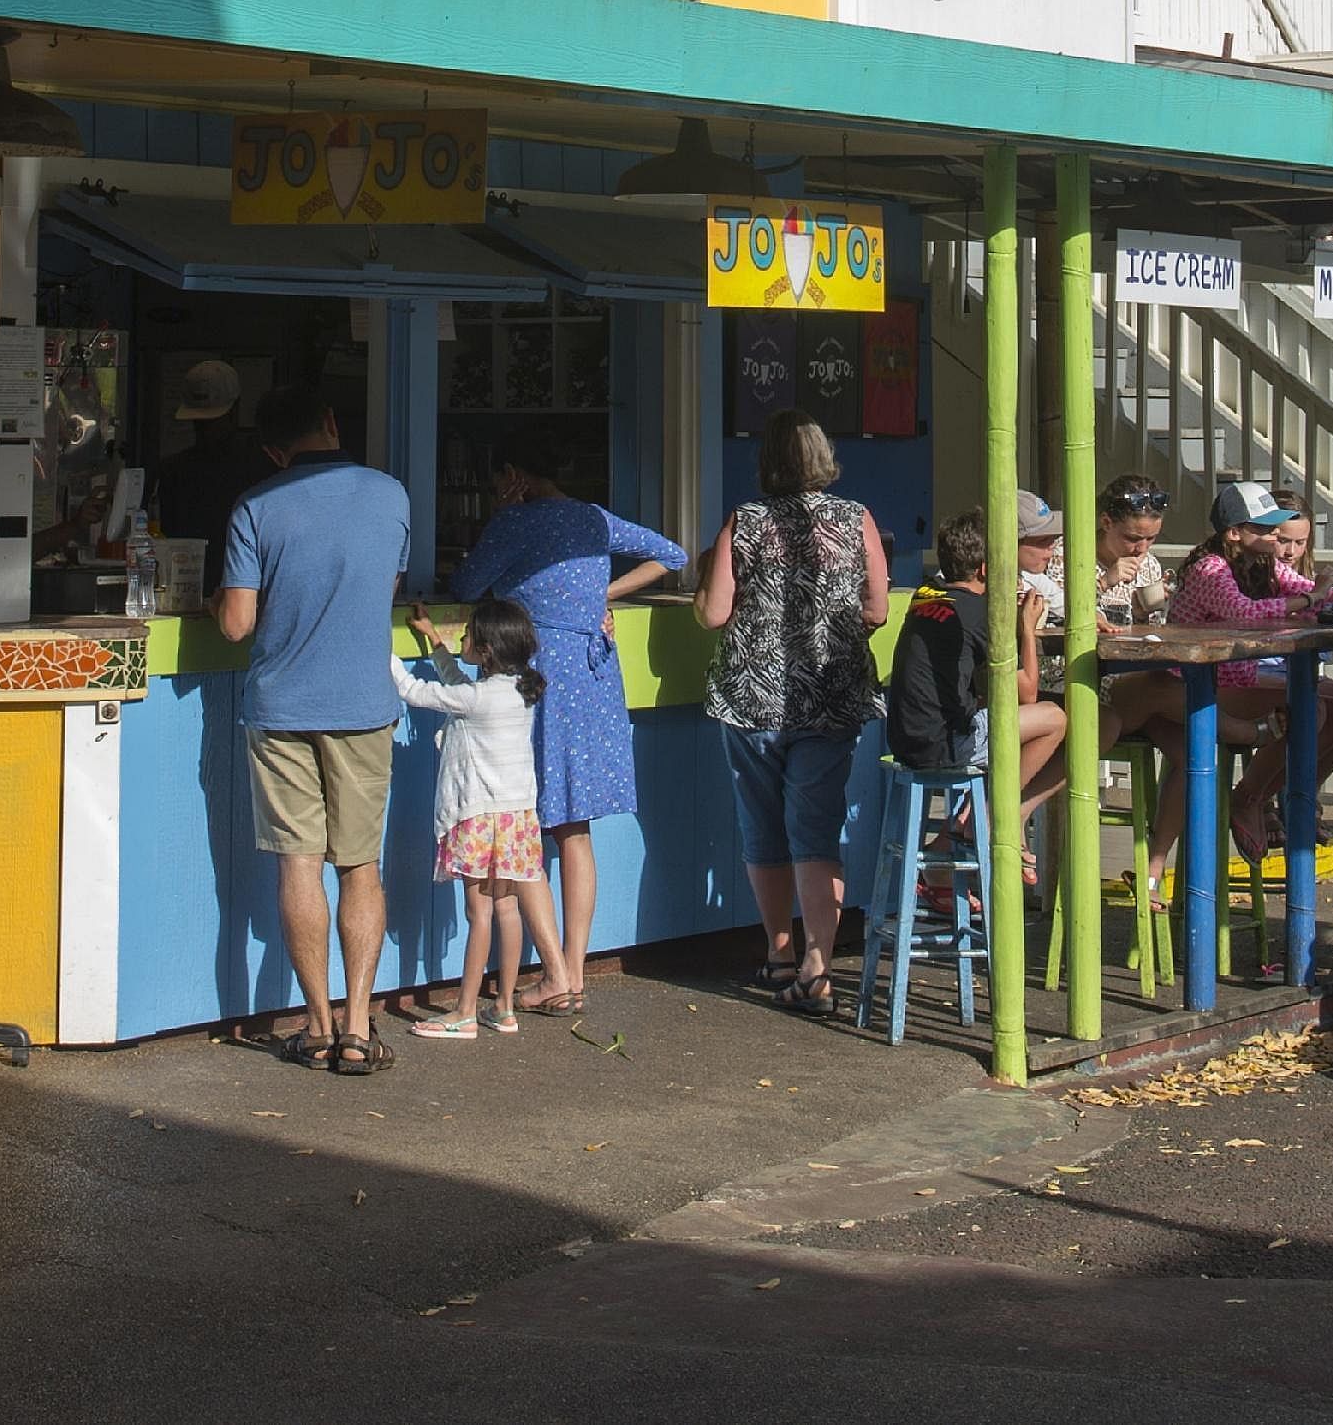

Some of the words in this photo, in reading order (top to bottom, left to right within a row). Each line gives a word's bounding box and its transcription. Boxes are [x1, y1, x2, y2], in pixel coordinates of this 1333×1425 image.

[237, 124, 317, 192] JO
[713, 205, 776, 272] JO
[1124, 246, 1168, 288] ICE
[1174, 253, 1235, 292] CREAM
